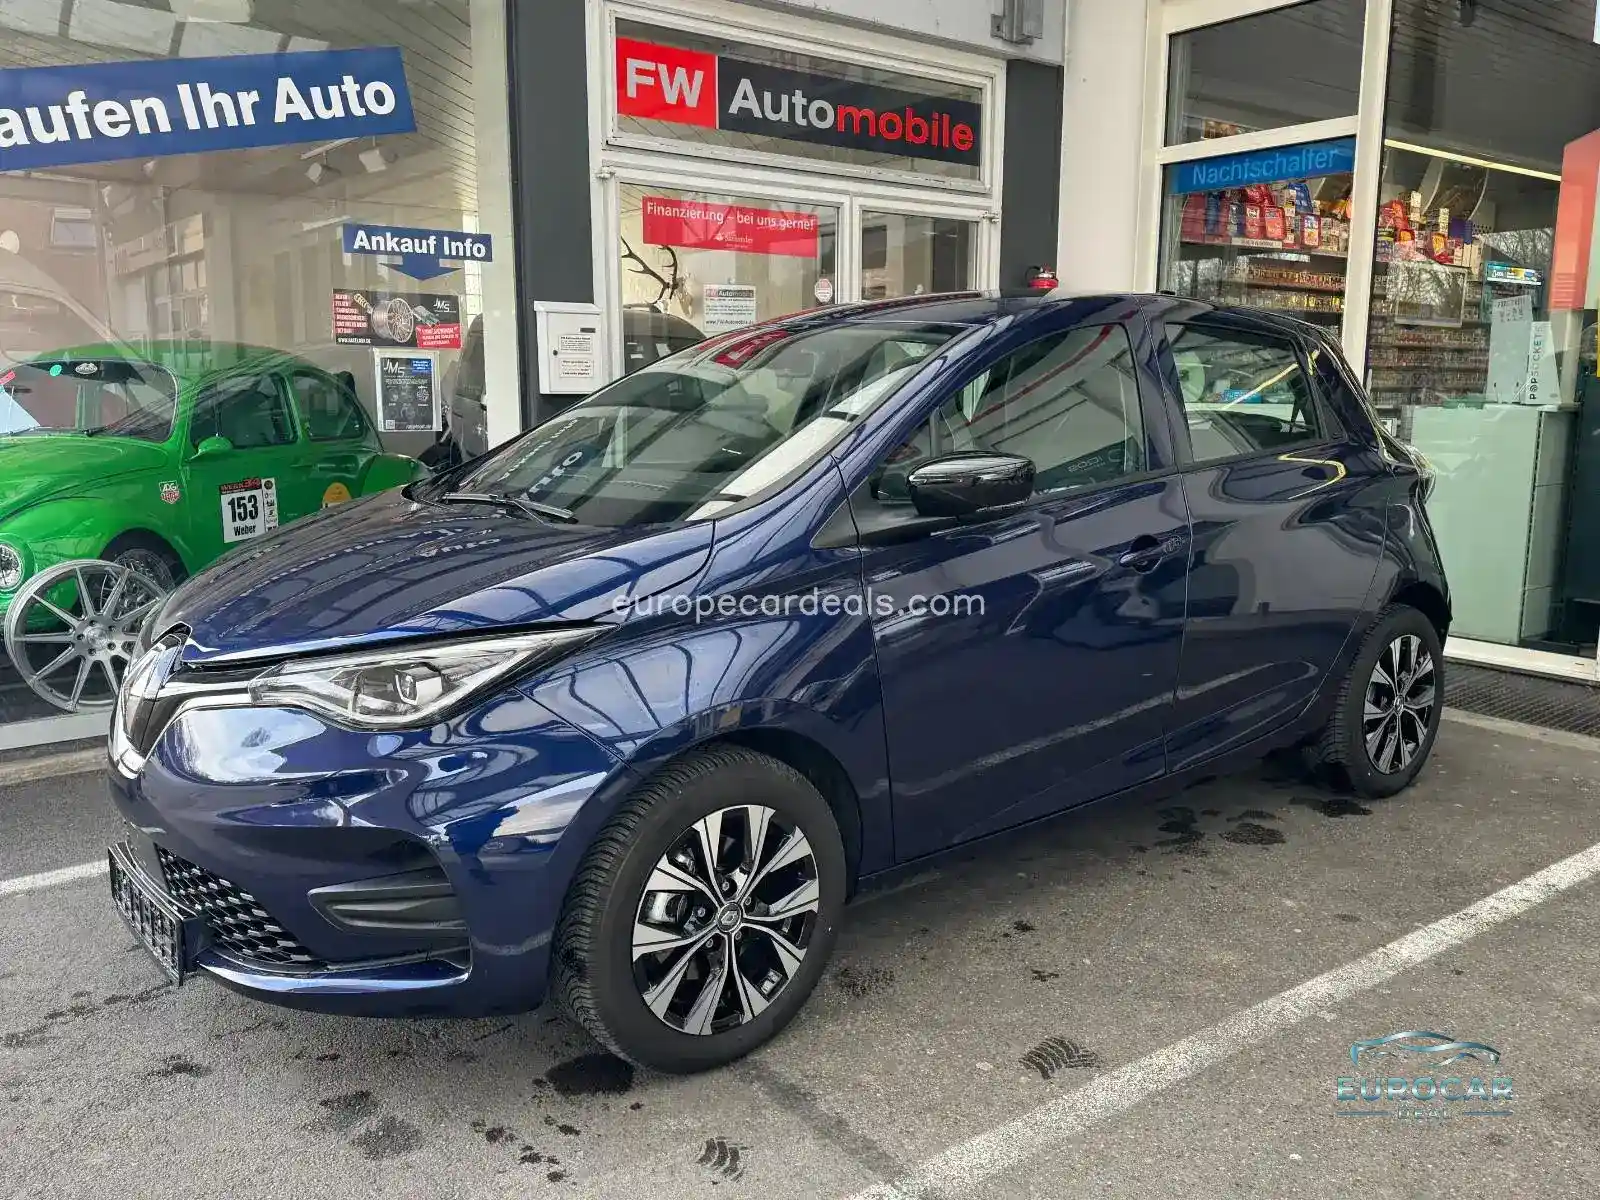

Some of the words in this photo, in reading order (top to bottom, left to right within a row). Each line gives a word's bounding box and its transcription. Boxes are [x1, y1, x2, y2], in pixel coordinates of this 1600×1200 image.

[0, 90, 171, 148] aufen
[177, 81, 259, 131] Ihr
[274, 75, 396, 123] Auto
[626, 57, 704, 108] FW
[728, 78, 975, 151] Automobile
[1193, 148, 1338, 185] Nachtschalter
[647, 202, 724, 225] Finanzierung
[737, 211, 754, 226] bei
[757, 215, 776, 228] uns
[776, 217, 815, 231] gerne!
[353, 229, 436, 254] Ankauf
[443, 236, 486, 258] Info
[227, 494, 259, 522] 153
[233, 525, 257, 536] Weber
